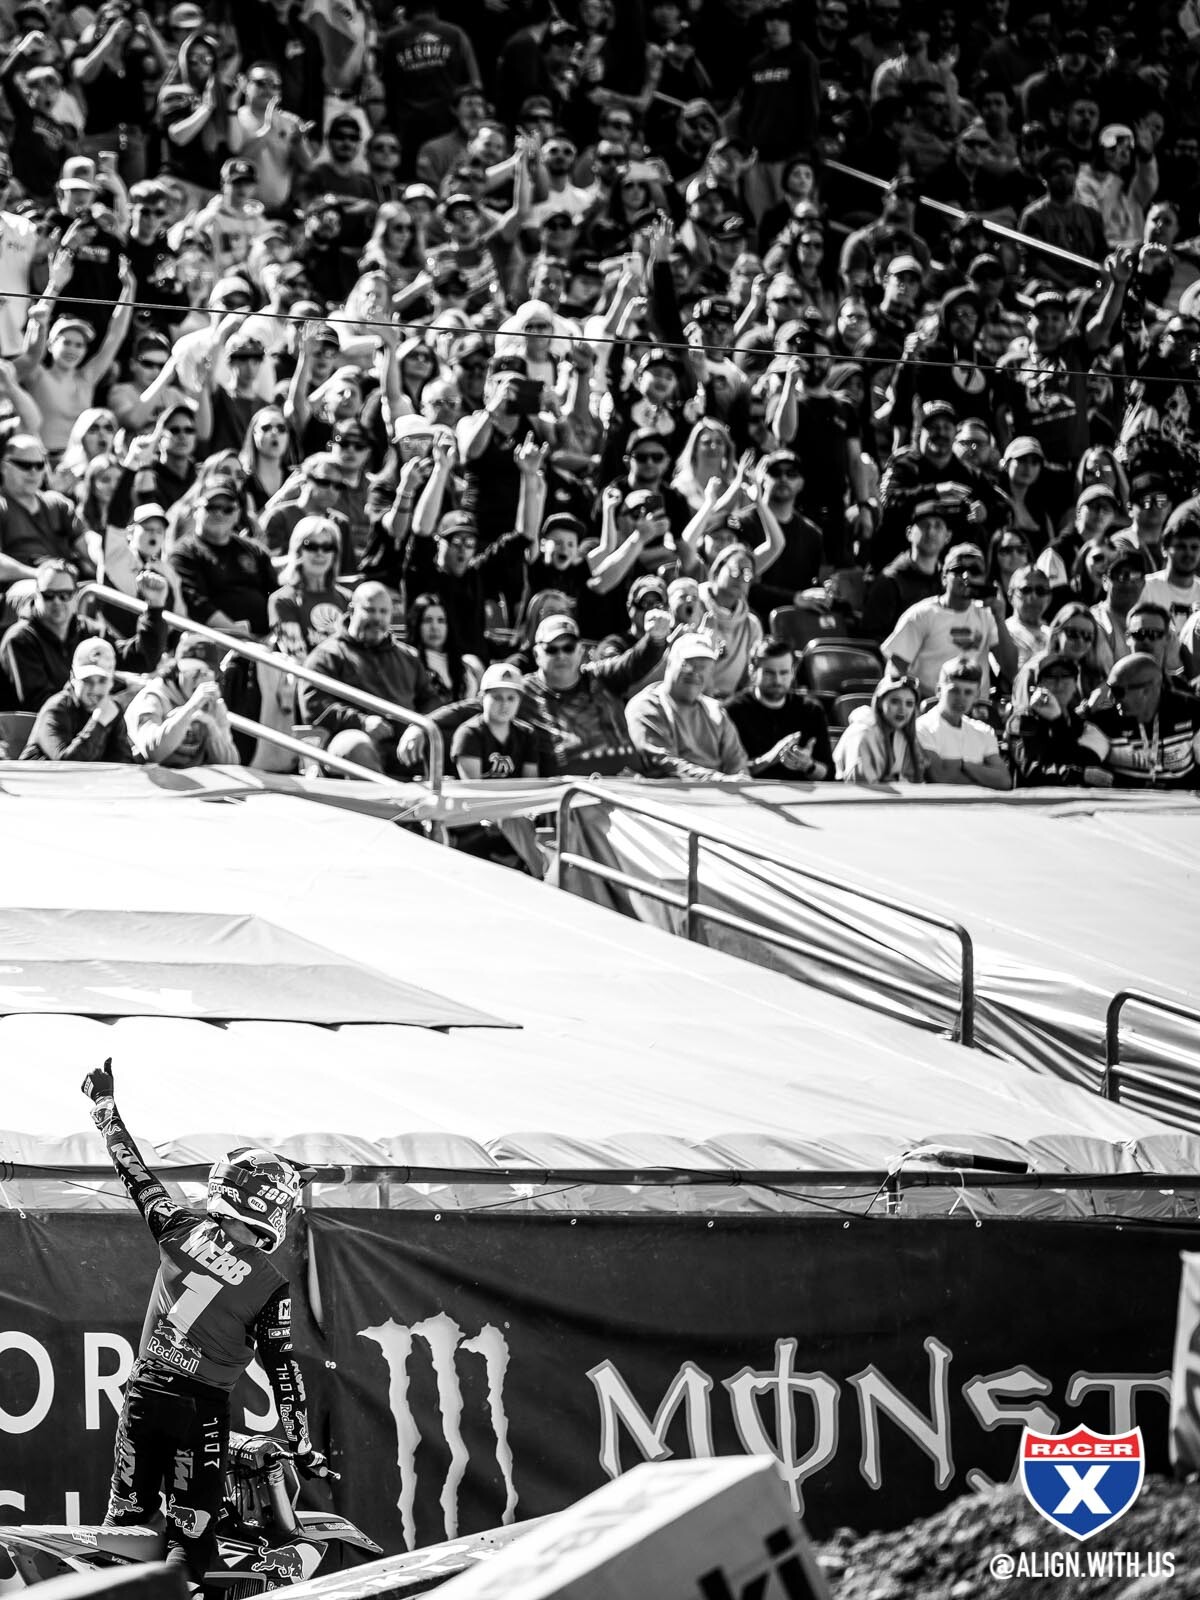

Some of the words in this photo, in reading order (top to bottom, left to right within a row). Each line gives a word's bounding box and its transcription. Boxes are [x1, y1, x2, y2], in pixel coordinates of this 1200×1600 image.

[250, 1198, 265, 1211] BELL
[180, 1221, 252, 1286] WEBB
[166, 1270, 225, 1335] 1
